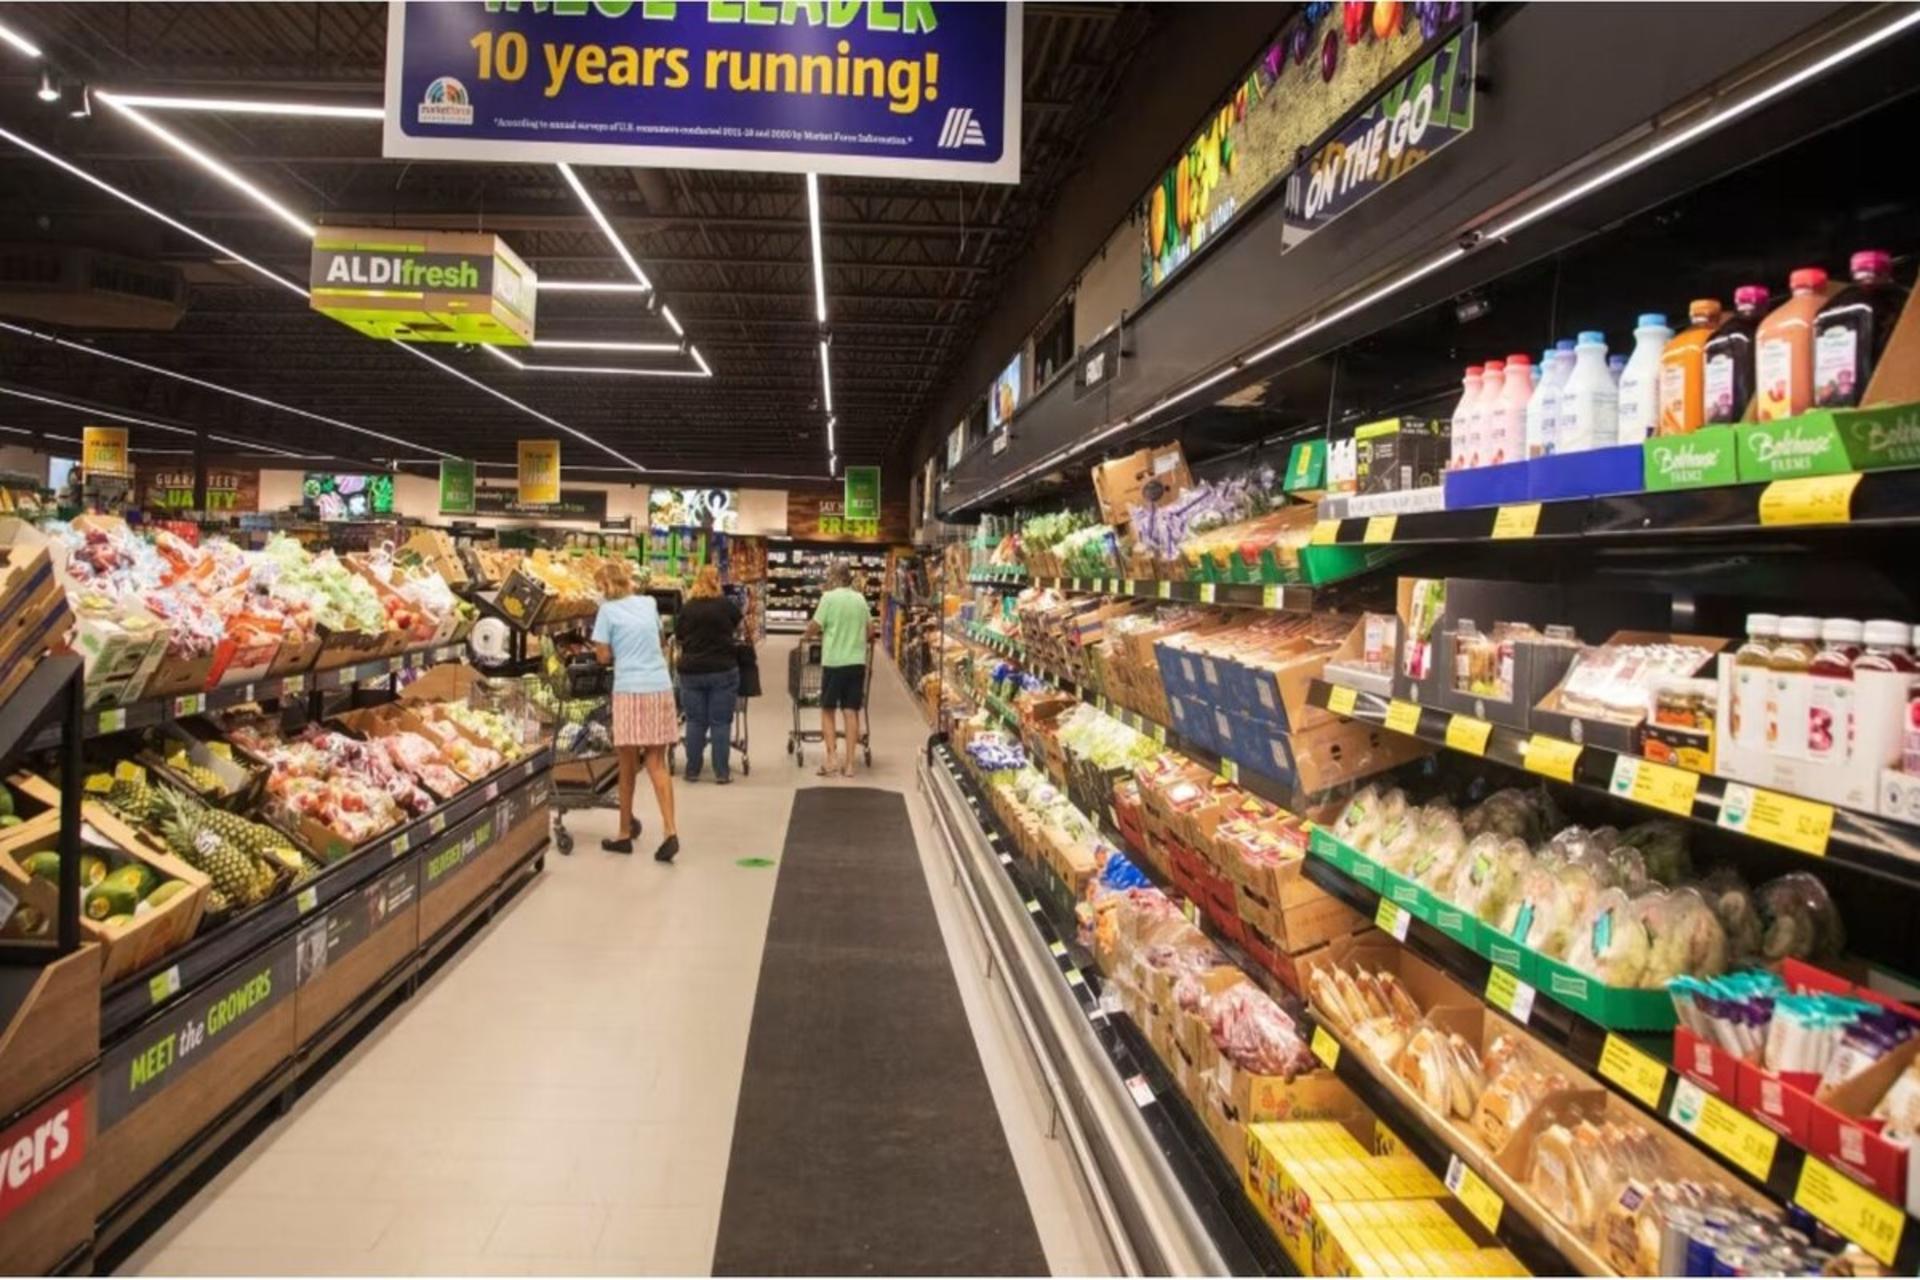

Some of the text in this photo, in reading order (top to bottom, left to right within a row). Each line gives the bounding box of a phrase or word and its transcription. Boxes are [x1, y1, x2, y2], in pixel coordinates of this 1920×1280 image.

[470, 31, 939, 113] 10 years running!
[1304, 154, 1341, 220] ON
[1340, 117, 1388, 195] THE
[1389, 82, 1434, 159] GO
[327, 256, 478, 288] ALDIfresh
[131, 968, 272, 1092] MEET the GROWERS
